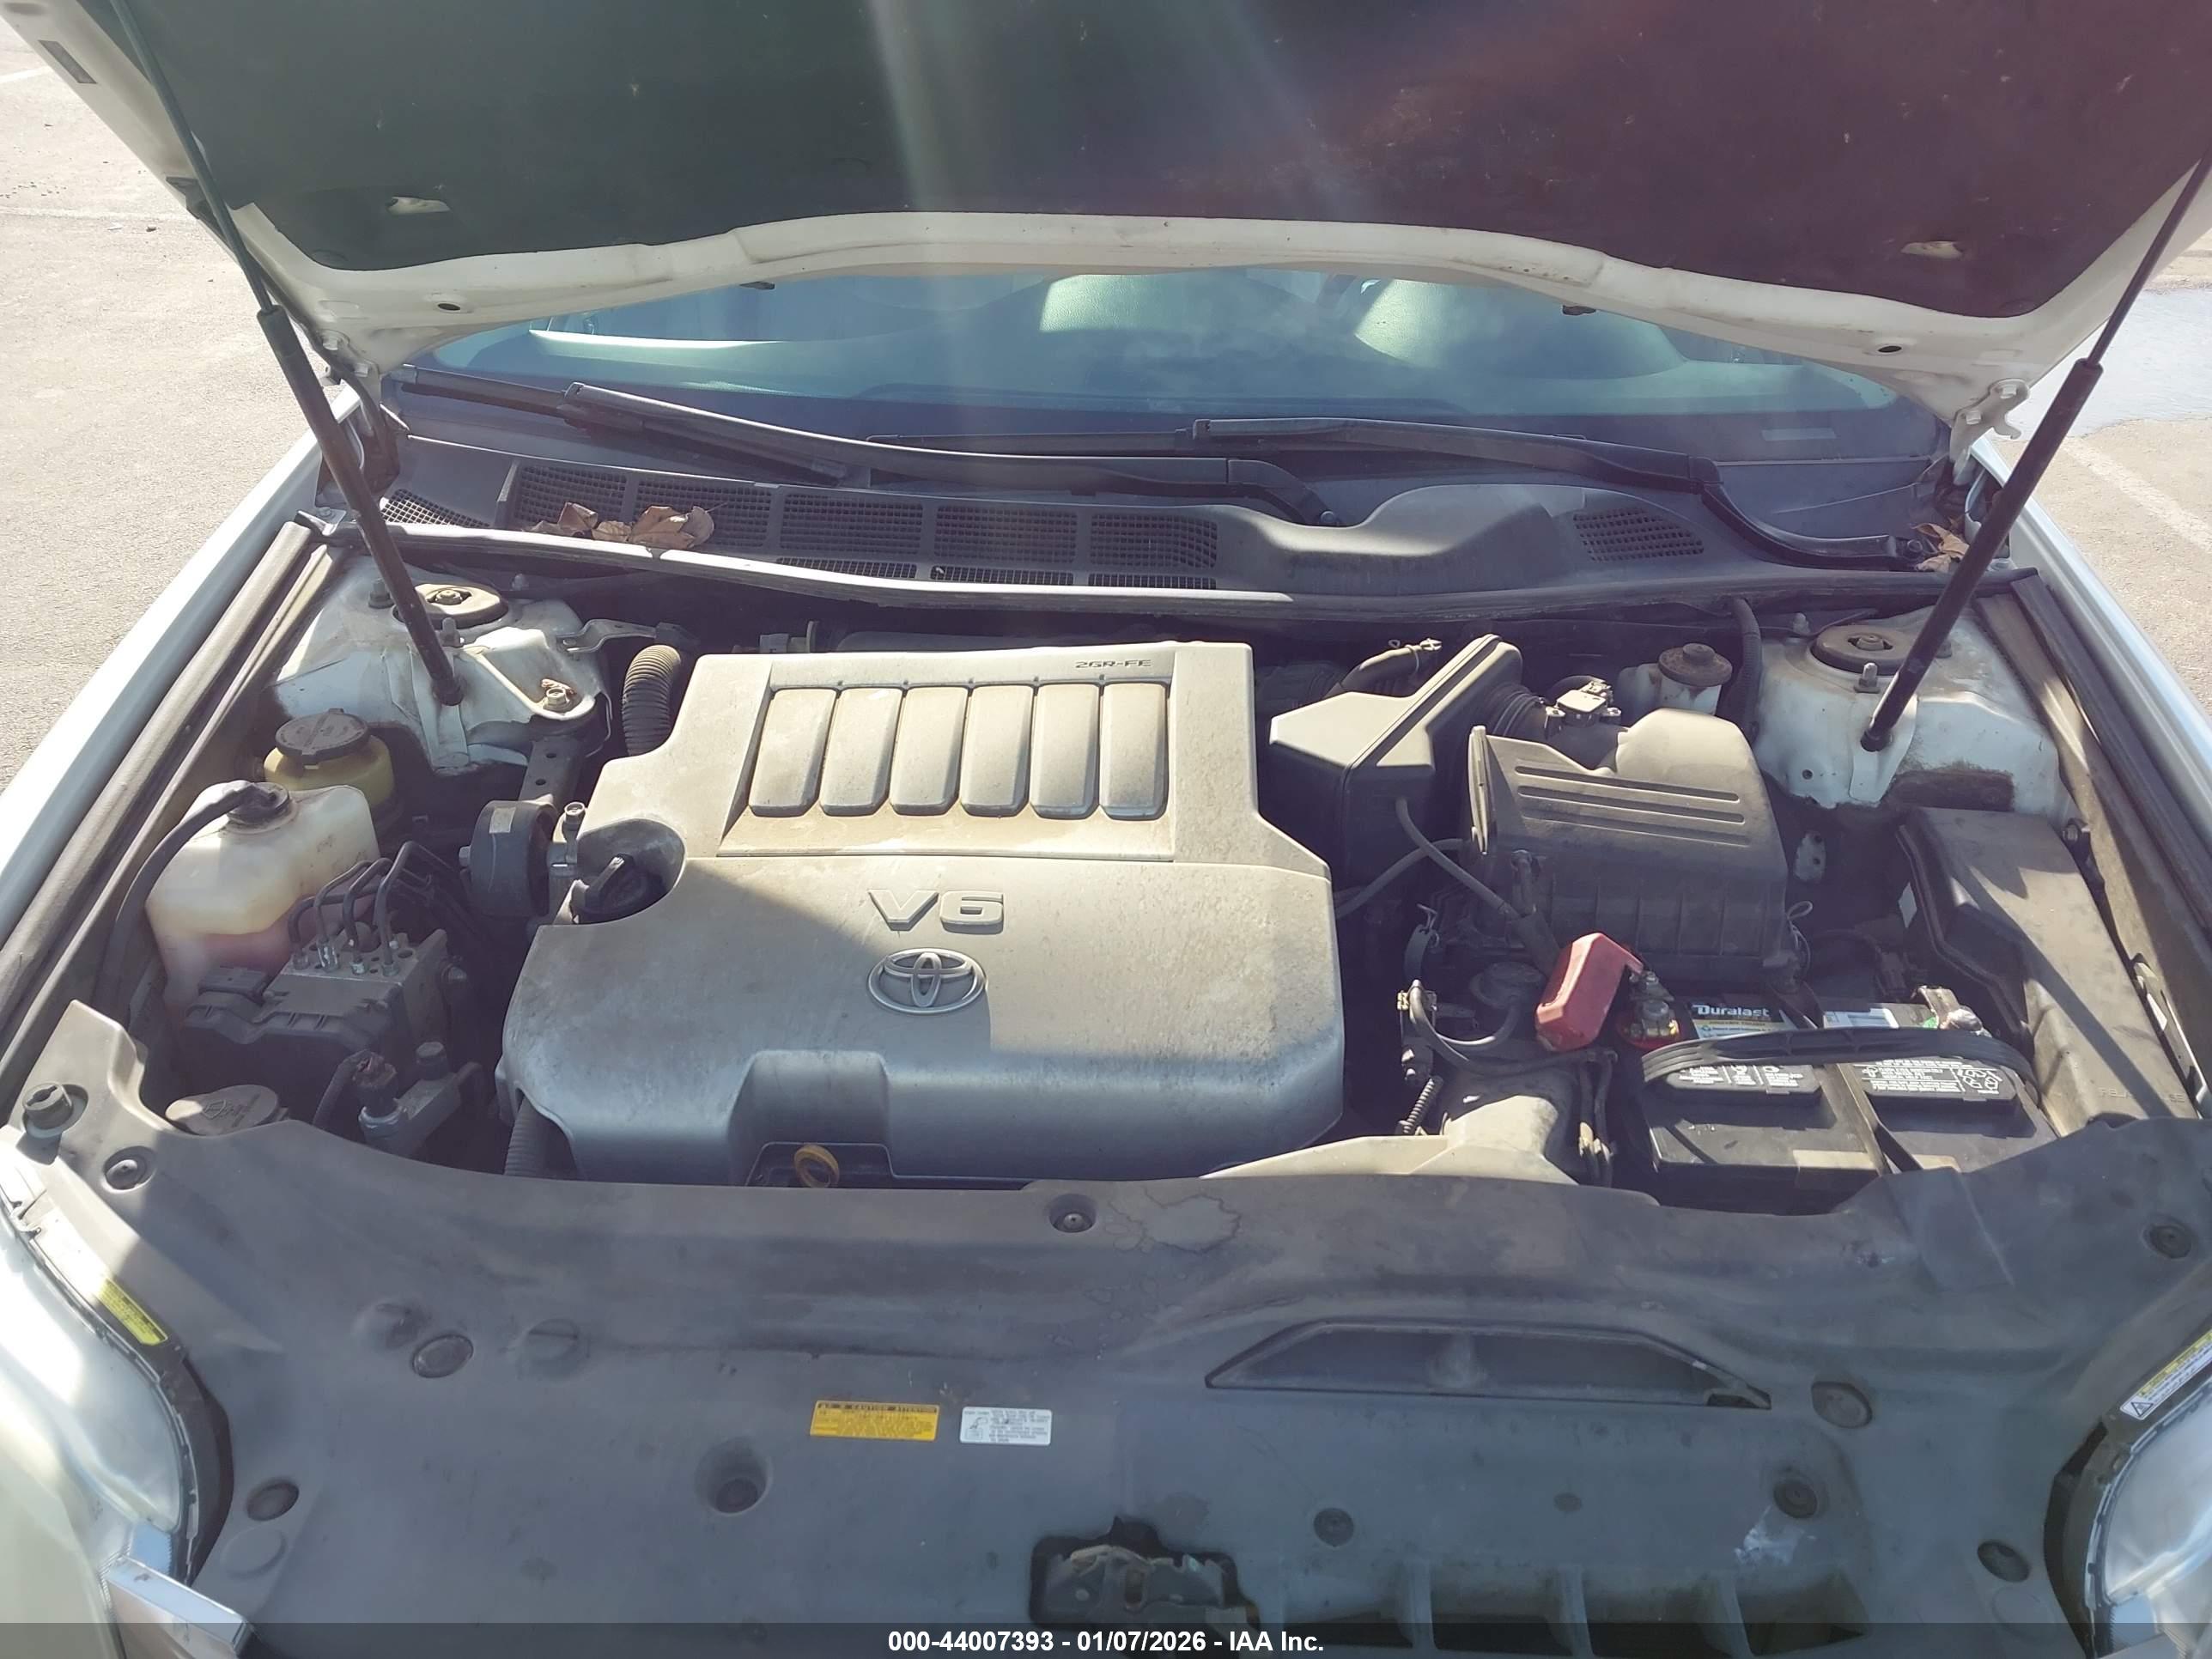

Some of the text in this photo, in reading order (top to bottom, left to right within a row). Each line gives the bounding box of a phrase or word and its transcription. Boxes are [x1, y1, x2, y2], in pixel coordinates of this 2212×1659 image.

[1074, 659, 1152, 669] 2GR-FE
[867, 888, 1005, 936] V6
[1691, 1004, 1771, 1018] Duralast
